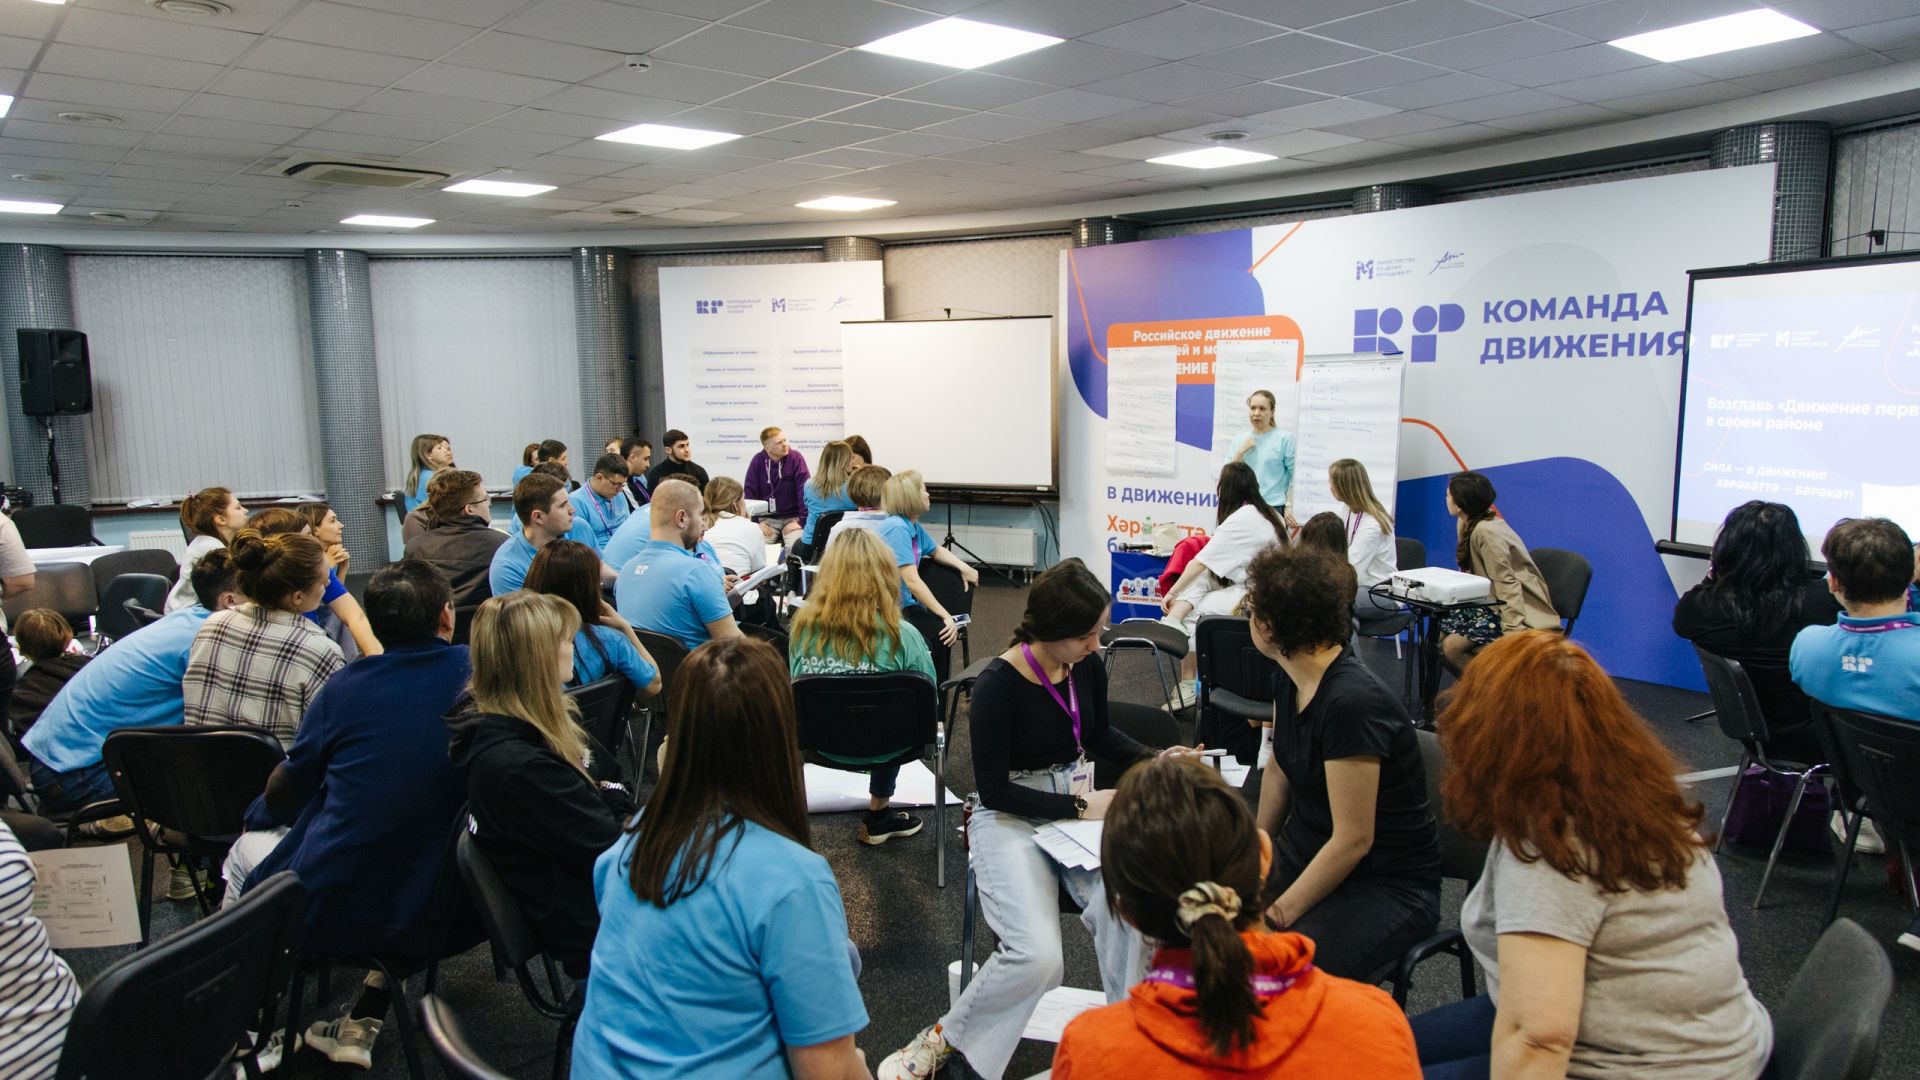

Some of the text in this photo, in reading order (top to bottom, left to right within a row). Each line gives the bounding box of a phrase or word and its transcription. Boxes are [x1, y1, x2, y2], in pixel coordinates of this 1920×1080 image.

[1483, 291, 1669, 324] КОМАНДА
[1133, 327, 1271, 342] Российское движение
[1480, 330, 1686, 365] ДВИЖЕНИЯ
[1177, 362, 1208, 374] ЕНИЕ
[1707, 397, 1920, 419] Возглавь «Движение перв
[1706, 416, 1823, 432] в своем районе
[1704, 462, 1732, 473] СИЛА
[1107, 486, 1117, 499] в
